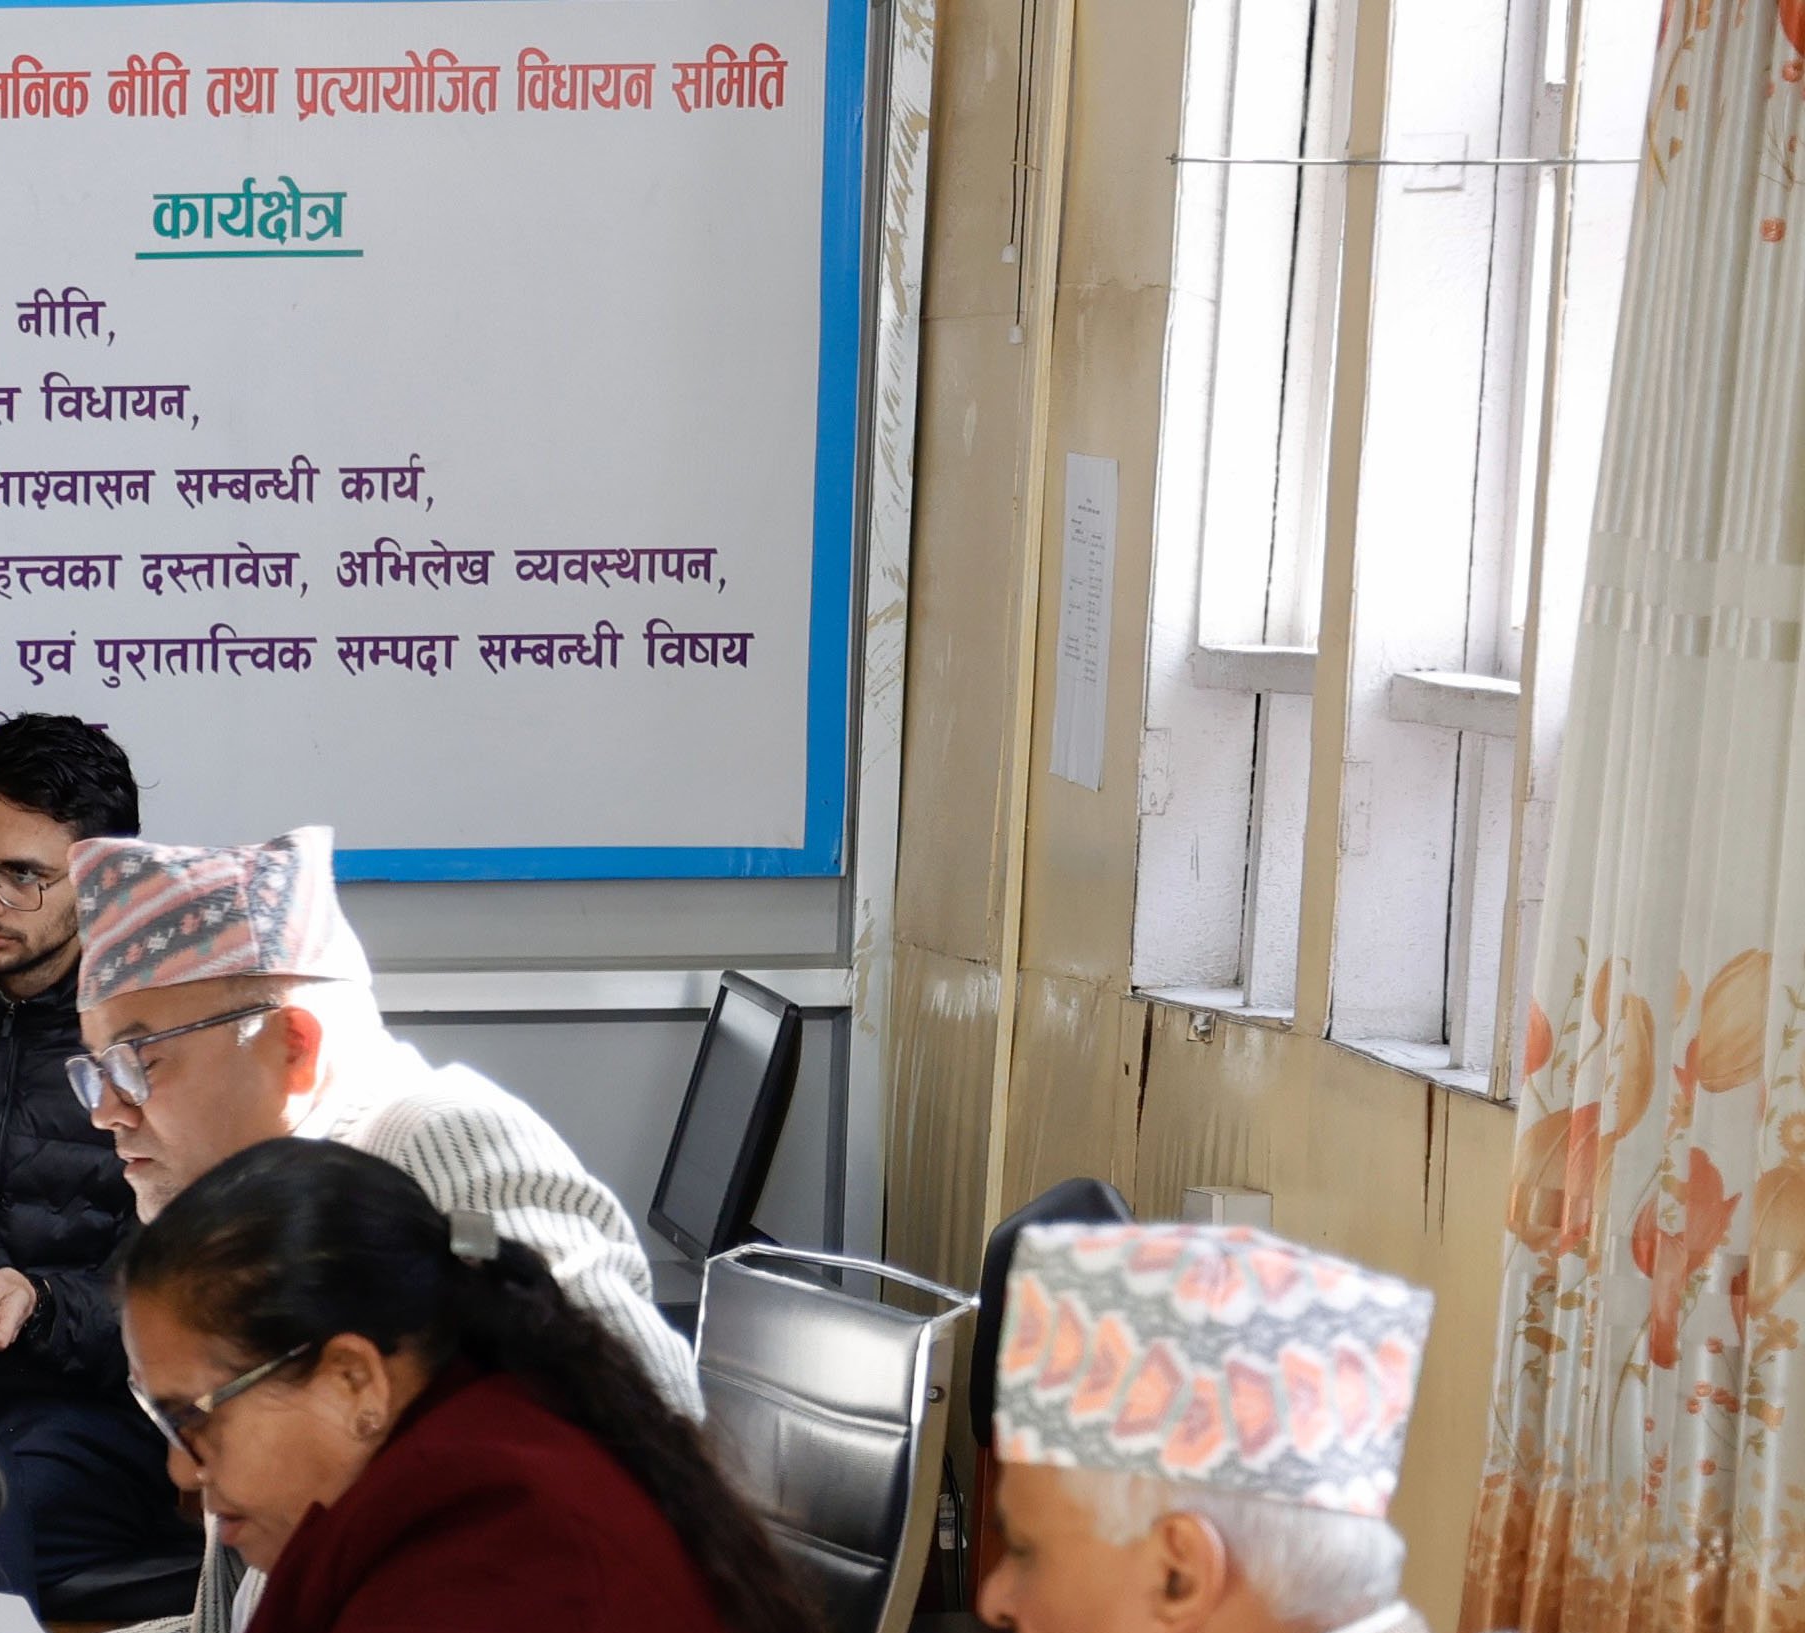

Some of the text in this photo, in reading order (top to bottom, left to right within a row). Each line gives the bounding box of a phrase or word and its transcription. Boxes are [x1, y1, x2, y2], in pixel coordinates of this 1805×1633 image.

[108, 52, 190, 118] नीति
[207, 67, 279, 117] तथा
[295, 48, 500, 121] प्रत्यायोजित
[517, 47, 656, 111] विधायन
[673, 43, 788, 113] समिति
[153, 176, 346, 244] कार्यक्षेत्र
[16, 287, 115, 346] नीति,
[40, 372, 199, 430] विधायन,
[175, 455, 320, 509] सम्बन्धी
[339, 453, 433, 512] कार्य,
[141, 542, 307, 597] दस्तावेज,
[337, 537, 495, 590] अभिलेख
[514, 548, 725, 593] व्यवस्थापन,
[16, 631, 76, 685] एवं
[94, 623, 317, 688] पुरातात्त्विक
[336, 635, 459, 677] सम्पदा
[478, 620, 624, 674] सम्बन्धी
[643, 618, 755, 668] विषय
